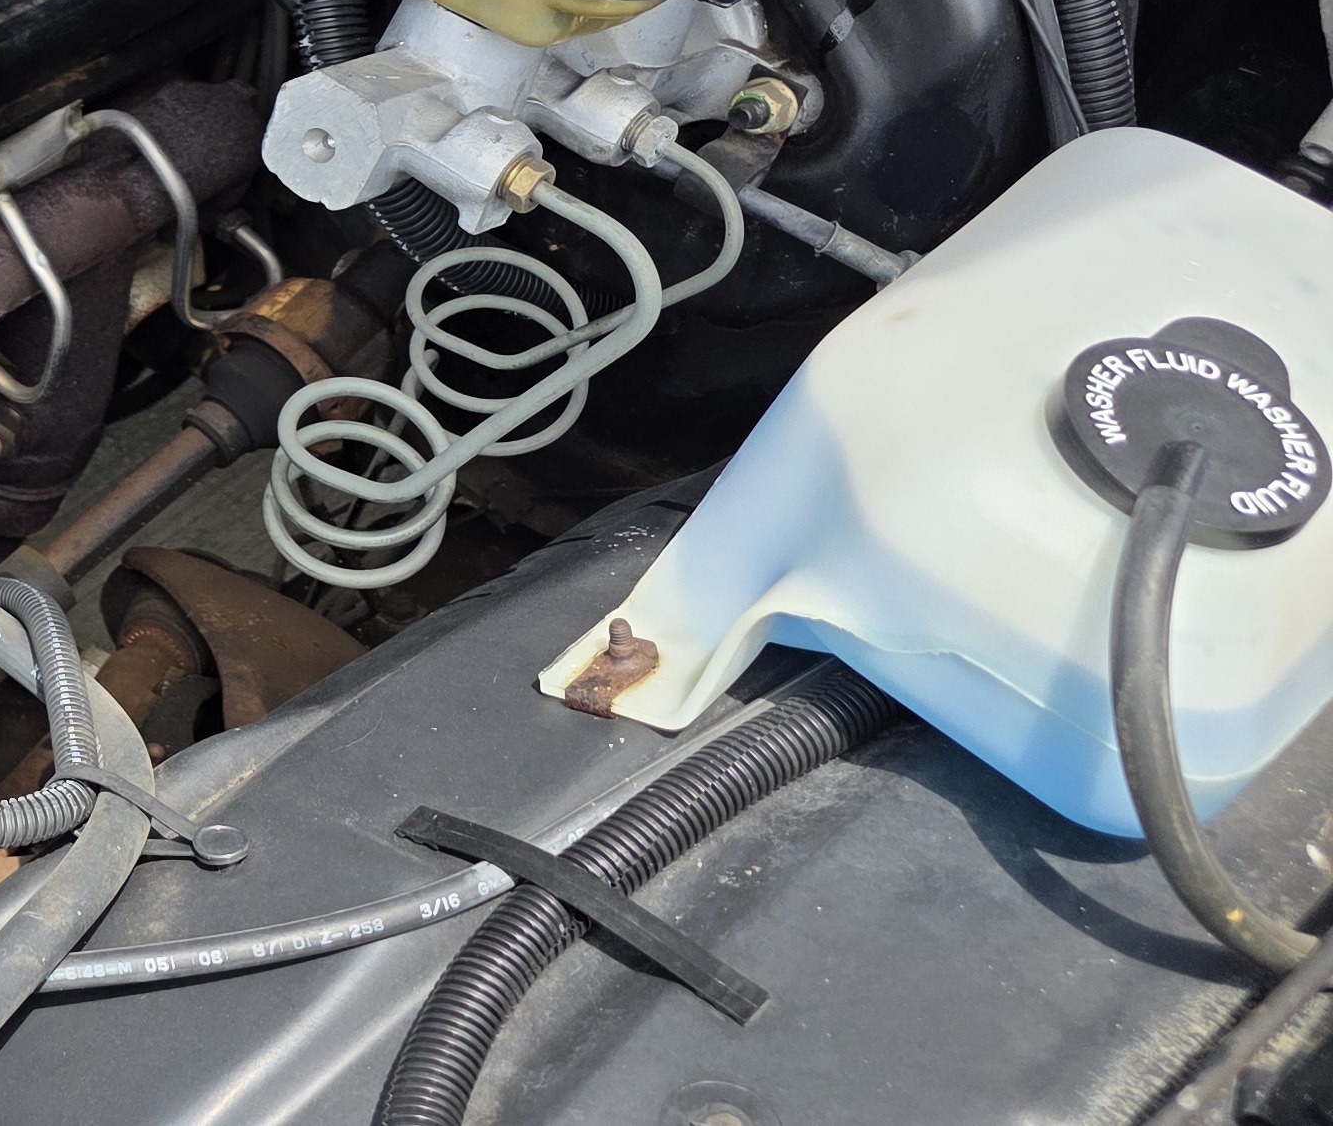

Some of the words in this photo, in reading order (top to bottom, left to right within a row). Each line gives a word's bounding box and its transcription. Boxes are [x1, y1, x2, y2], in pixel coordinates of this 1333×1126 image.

[1126, 348, 1221, 380] FLUID
[1086, 356, 1133, 445] WASHER
[1227, 373, 1317, 476] WASHER
[1230, 470, 1311, 516] FLUID
[419, 891, 461, 921] 3/16
